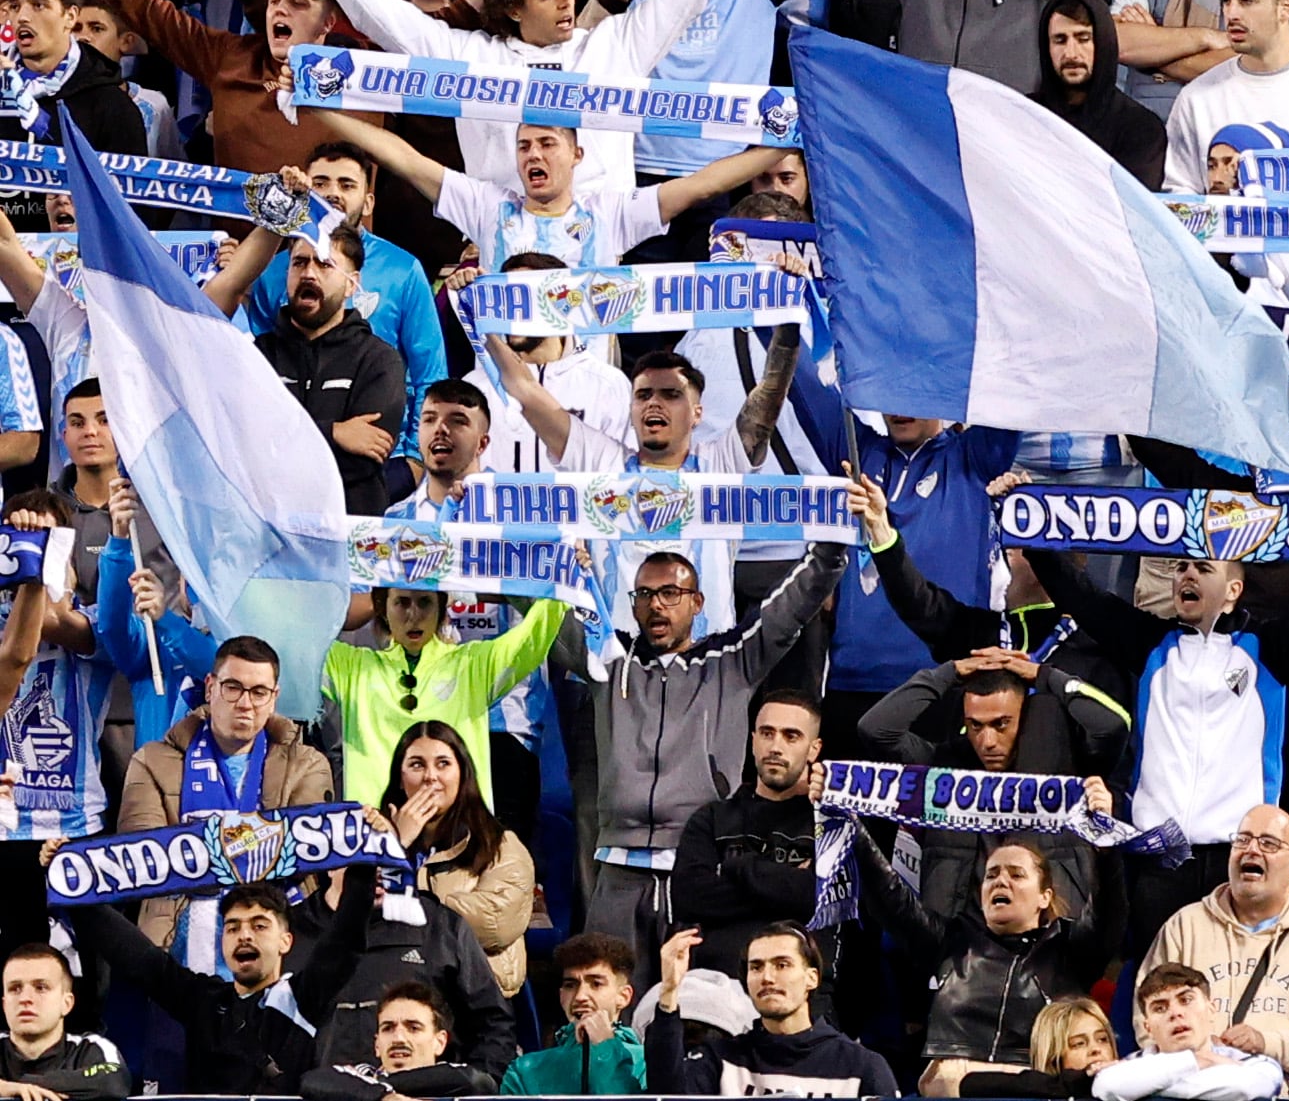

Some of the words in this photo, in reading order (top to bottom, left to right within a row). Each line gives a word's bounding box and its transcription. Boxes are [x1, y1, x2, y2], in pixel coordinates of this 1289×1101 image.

[361, 64, 427, 98] UNA
[431, 70, 520, 107] COSA
[526, 77, 750, 127] INEXPLICABLE
[152, 157, 234, 185] LEAL
[1000, 491, 1186, 545] ONDO
[47, 832, 210, 898] ONDO
